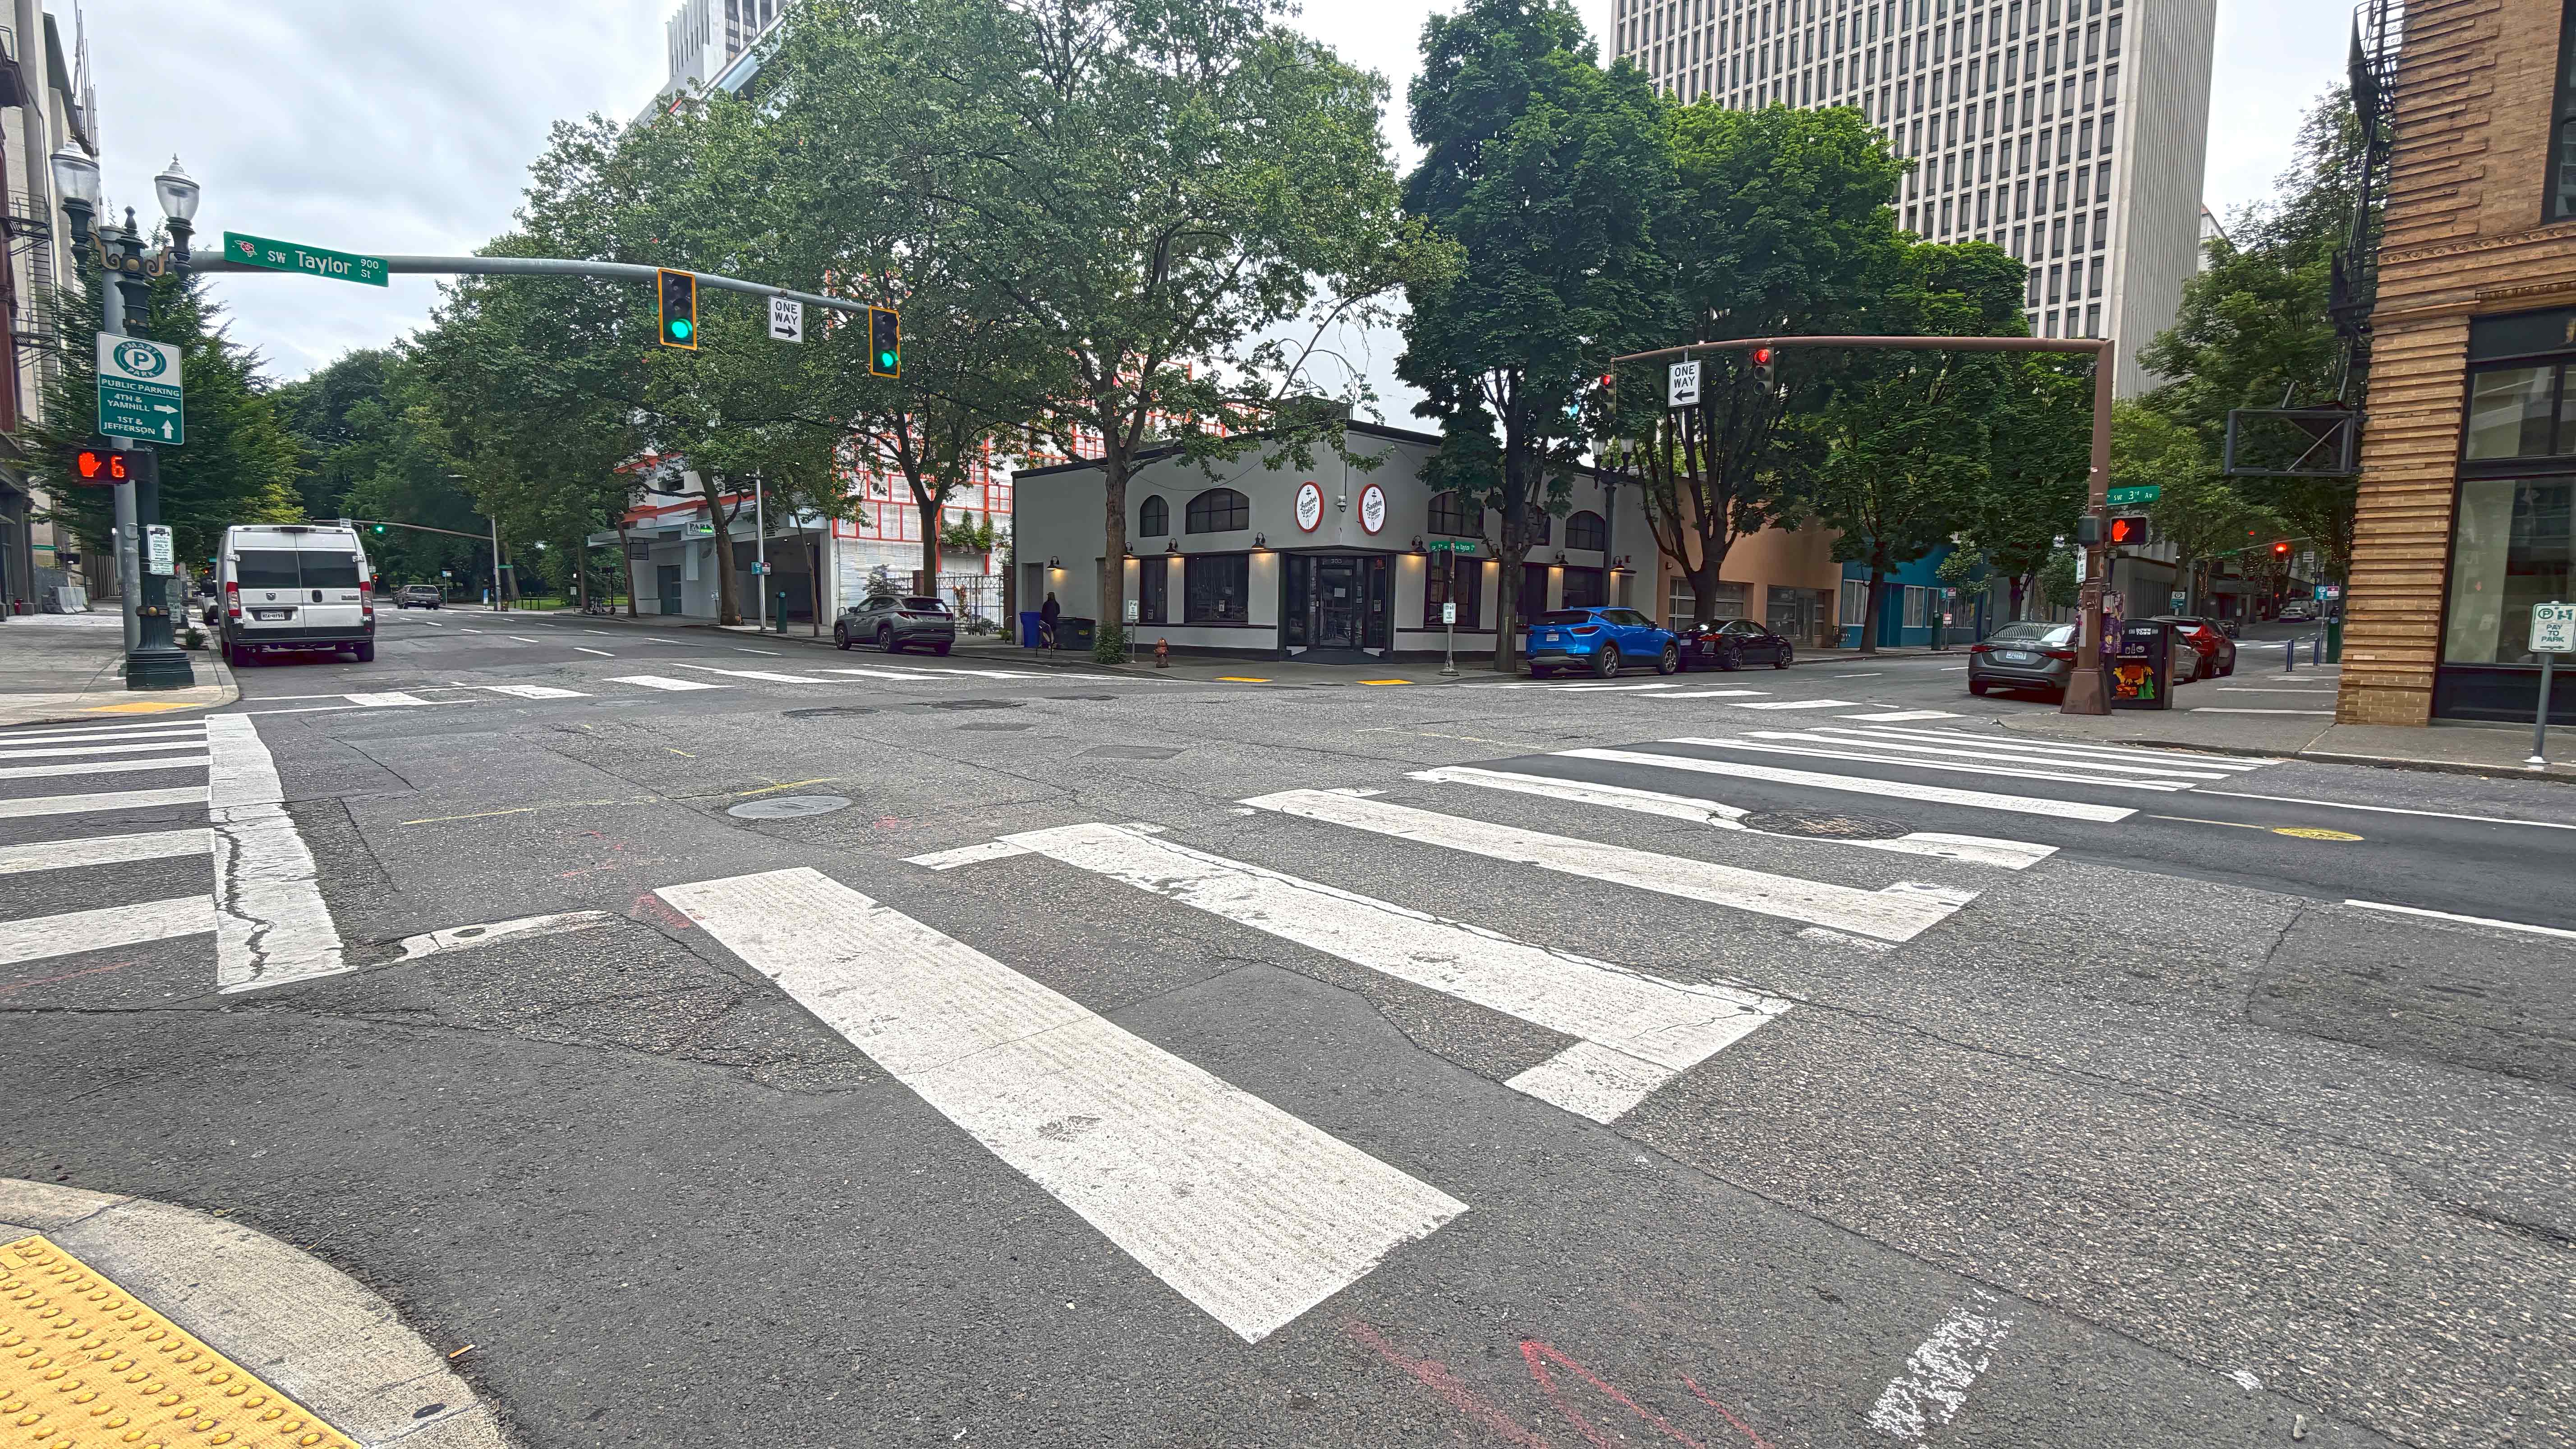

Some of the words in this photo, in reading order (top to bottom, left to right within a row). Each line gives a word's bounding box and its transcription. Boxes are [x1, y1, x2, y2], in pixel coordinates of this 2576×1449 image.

[267, 250, 286, 264] SW
[294, 250, 353, 275] Taylor
[360, 258, 379, 269] 900
[361, 269, 371, 278] St
[775, 301, 798, 314] ONE
[774, 312, 798, 325] WAY
[121, 342, 159, 354] SMART
[133, 351, 149, 366] P
[127, 368, 156, 377] PARK
[1674, 364, 1695, 377] ONE
[101, 378, 136, 391] PUBLIC
[138, 384, 179, 397] PARKING
[1674, 376, 1695, 388] WAY
[114, 393, 133, 401] 4TH
[107, 399, 150, 412] YAMHILL
[103, 422, 156, 435] JEFFERSON
[110, 455, 124, 478] 6
[2129, 491, 2139, 500] 3rd
